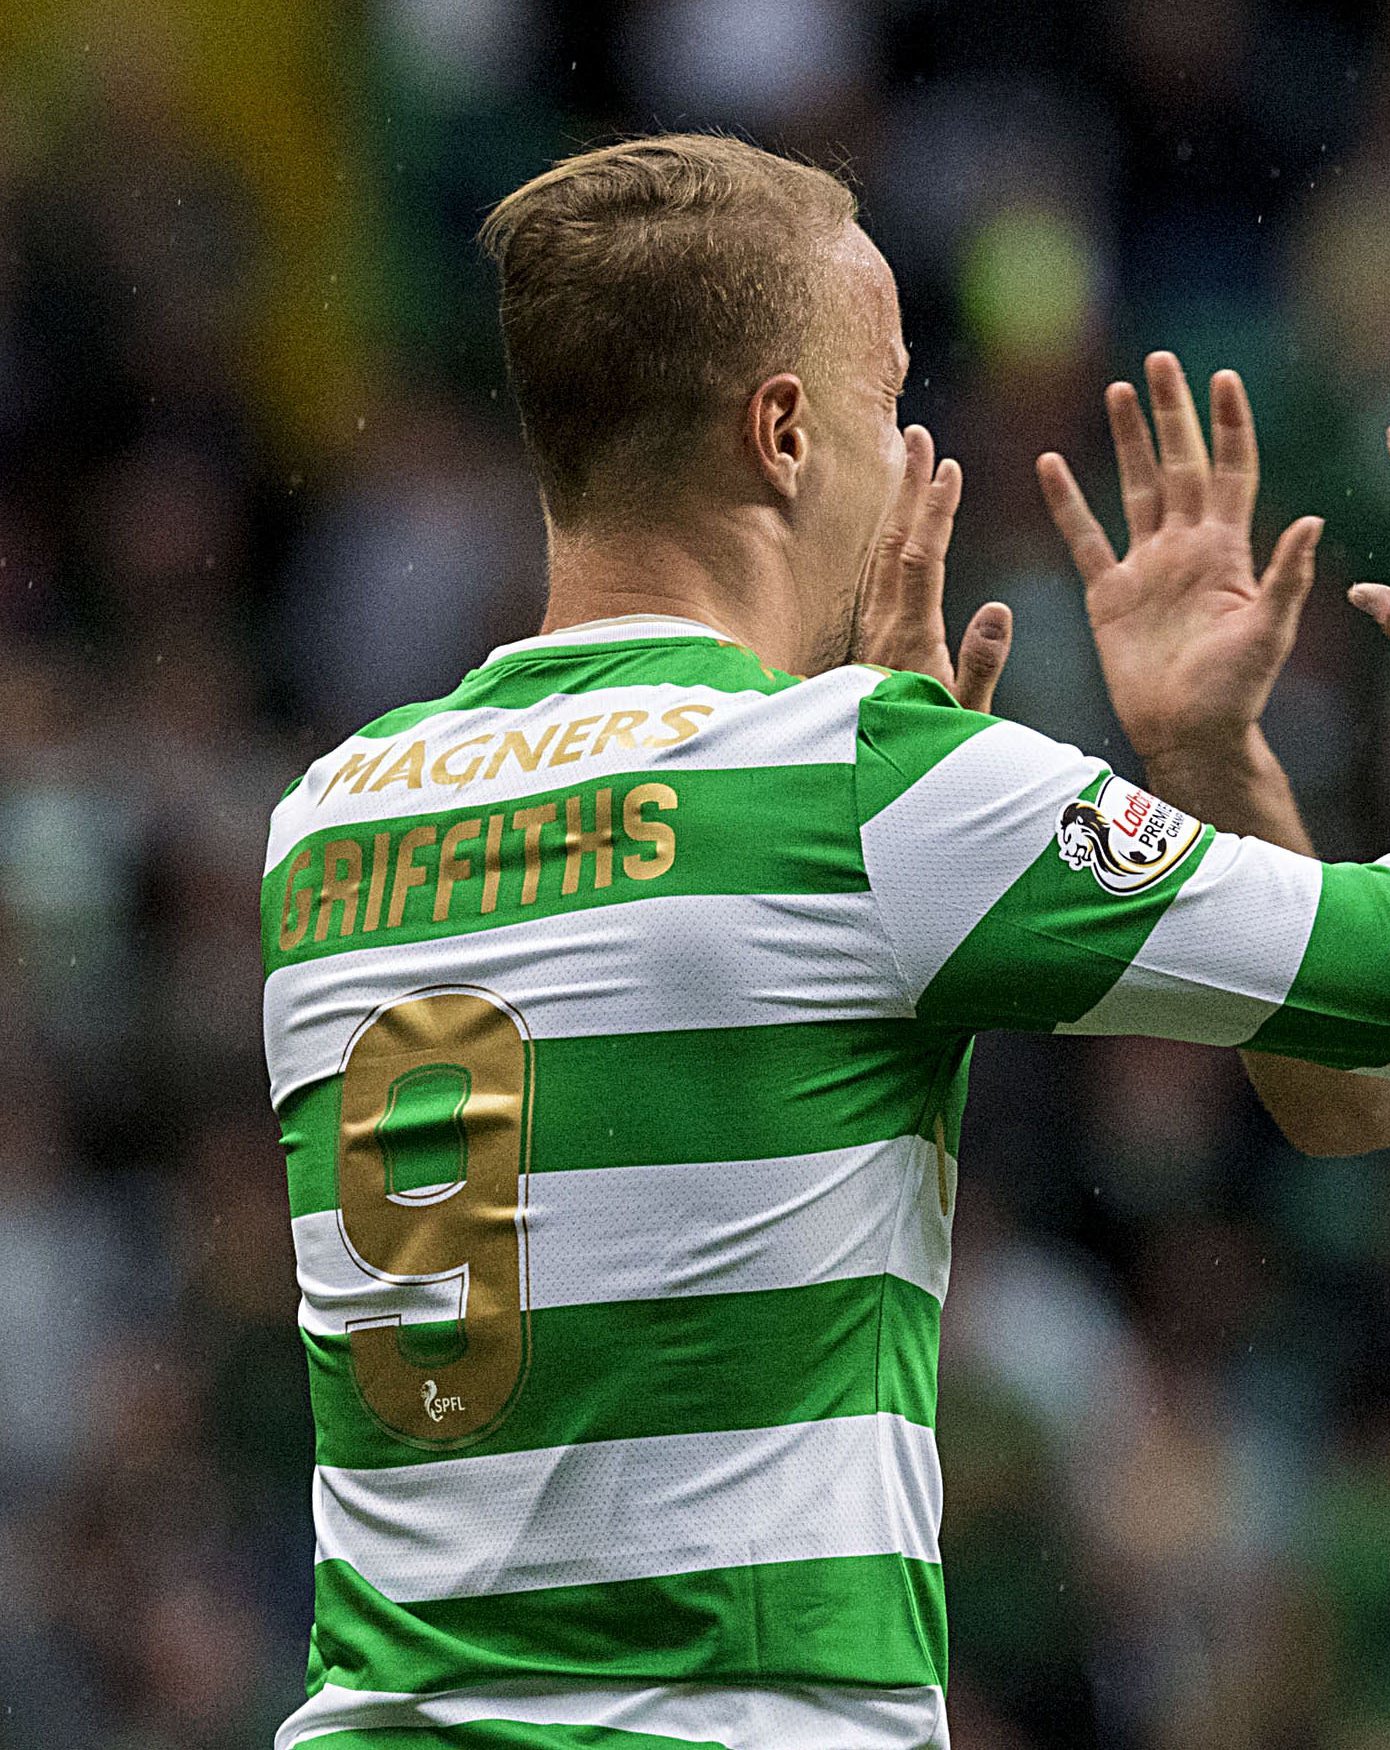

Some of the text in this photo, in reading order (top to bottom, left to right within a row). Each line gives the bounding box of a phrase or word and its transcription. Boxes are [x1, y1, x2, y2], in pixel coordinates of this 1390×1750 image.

[316, 704, 715, 807] MAGNERS
[278, 782, 679, 951] GRIFFITHS
[336, 985, 534, 1449] 9
[434, 1396, 466, 1413] SPFL
